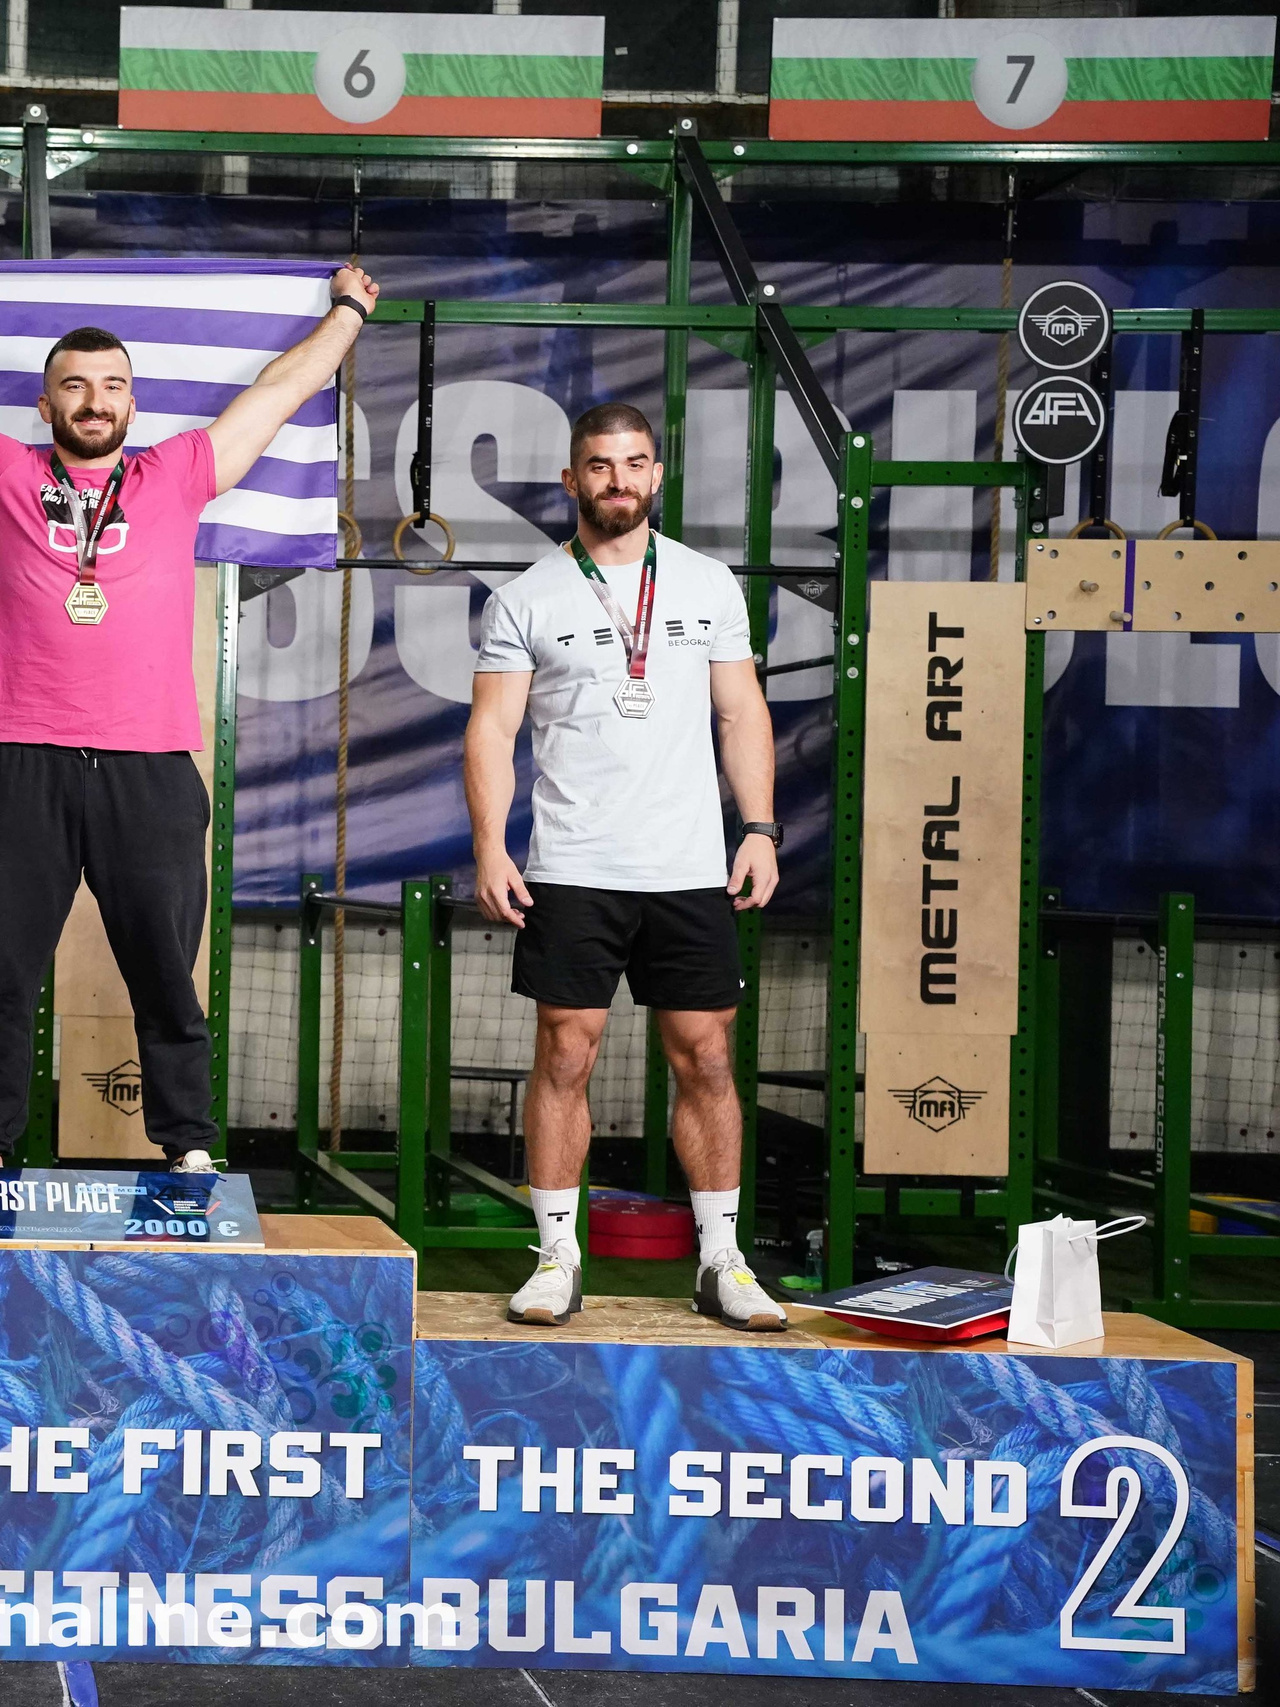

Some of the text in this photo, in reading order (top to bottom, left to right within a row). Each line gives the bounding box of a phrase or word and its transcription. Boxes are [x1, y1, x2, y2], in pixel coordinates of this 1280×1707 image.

[344, 49, 375, 98] 6
[1007, 55, 1035, 104] 7
[668, 638, 711, 647] BEOGRAD
[920, 611, 965, 1005] METAL ART
[1157, 945, 1167, 1026] METAL
[1156, 1034, 1166, 1080] ART
[46, 1182, 122, 1214] PLACE
[124, 1219, 240, 1237] 2000 €
[123, 1428, 381, 1498] FIRST
[463, 1445, 1027, 1527] THE SECOND
[1060, 1436, 1189, 1655] 2
[423, 1577, 919, 1664] BULGARIA
